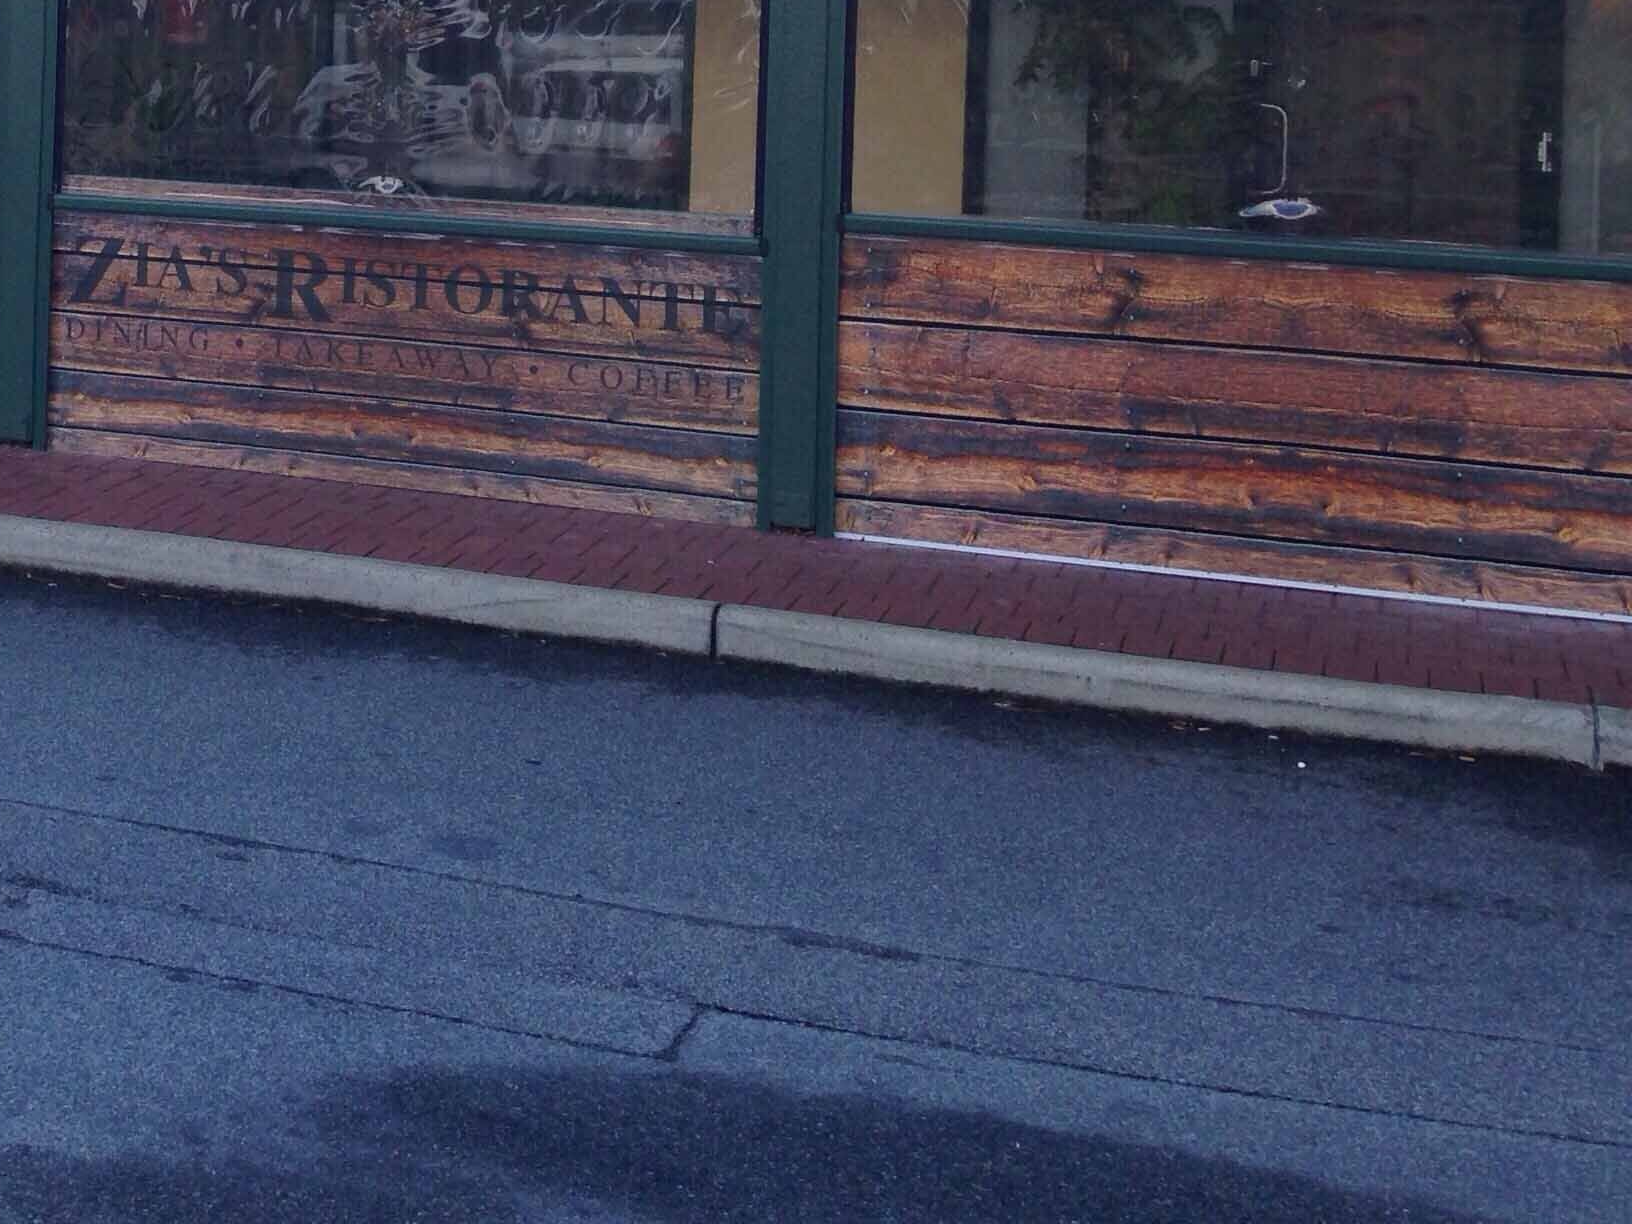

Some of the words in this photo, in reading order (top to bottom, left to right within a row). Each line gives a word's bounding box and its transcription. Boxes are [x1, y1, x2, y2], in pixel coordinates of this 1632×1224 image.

[270, 247, 746, 333] RISTORANTE
[67, 317, 209, 351] DINING
[270, 335, 499, 379] TAKEAWAY
[569, 360, 746, 402] COFFEE
